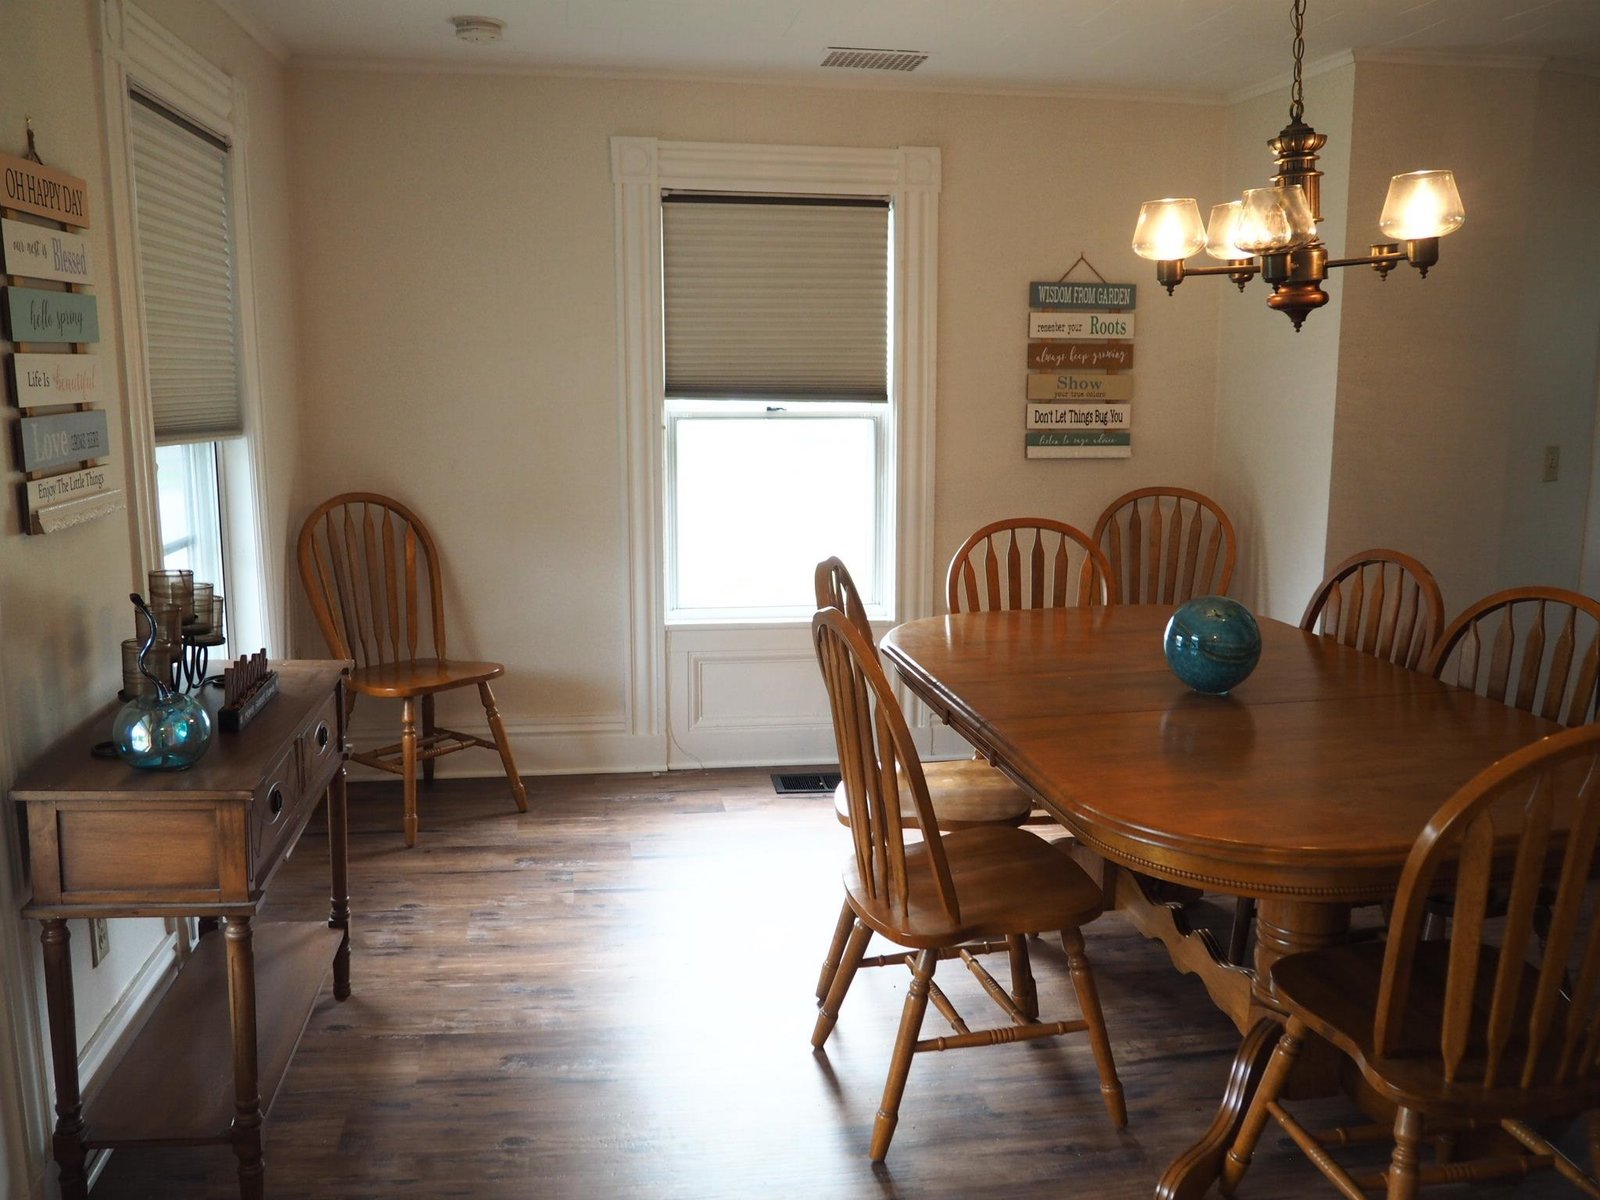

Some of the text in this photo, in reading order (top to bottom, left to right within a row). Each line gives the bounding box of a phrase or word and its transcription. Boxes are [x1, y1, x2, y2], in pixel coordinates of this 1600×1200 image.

[6, 168, 82, 217] OH HAPPY DAY
[51, 237, 87, 275] Blessed
[1038, 285, 1131, 305] WISDOM FROM GARDEN
[31, 299, 82, 336] hello spring
[1067, 324, 1083, 335] your
[1090, 315, 1127, 335] Roots
[1036, 347, 1066, 366] always
[1092, 349, 1128, 364] growing
[28, 364, 95, 400] Life Is beautiful
[1057, 375, 1103, 390] Show
[1034, 409, 1123, 425] Don't Let Things Bug You
[31, 423, 68, 462] Love
[38, 471, 104, 503] Enjoy The Little Things
